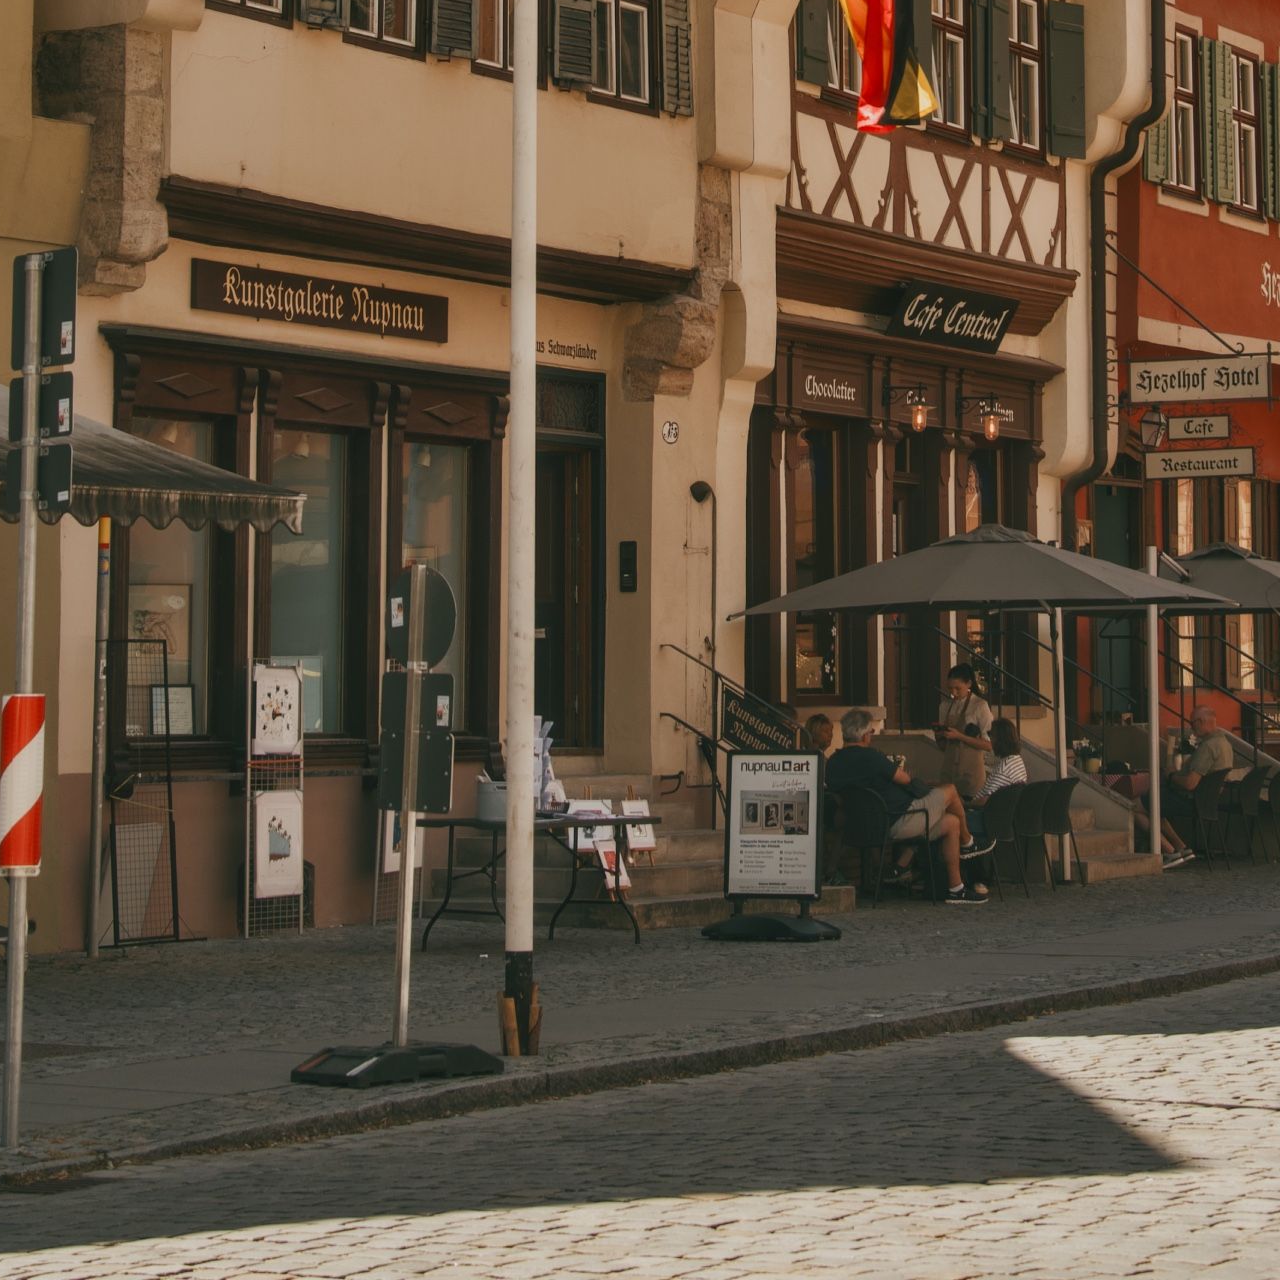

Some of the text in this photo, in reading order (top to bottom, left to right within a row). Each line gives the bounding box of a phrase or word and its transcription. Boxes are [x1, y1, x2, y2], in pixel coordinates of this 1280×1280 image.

[222, 266, 425, 332] Kunstgalerie Nupnau
[903, 293, 1010, 342] Cafe Central
[805, 374, 856, 401] Chocolatier
[1135, 365, 1261, 394] Hezelhof Hotel
[1183, 418, 1214, 437] Cafe
[1160, 456, 1239, 472] Restaurant
[727, 699, 793, 749] Kunstgalerie
[730, 720, 770, 750] Nupna
[740, 760, 811, 775] nupnau art
